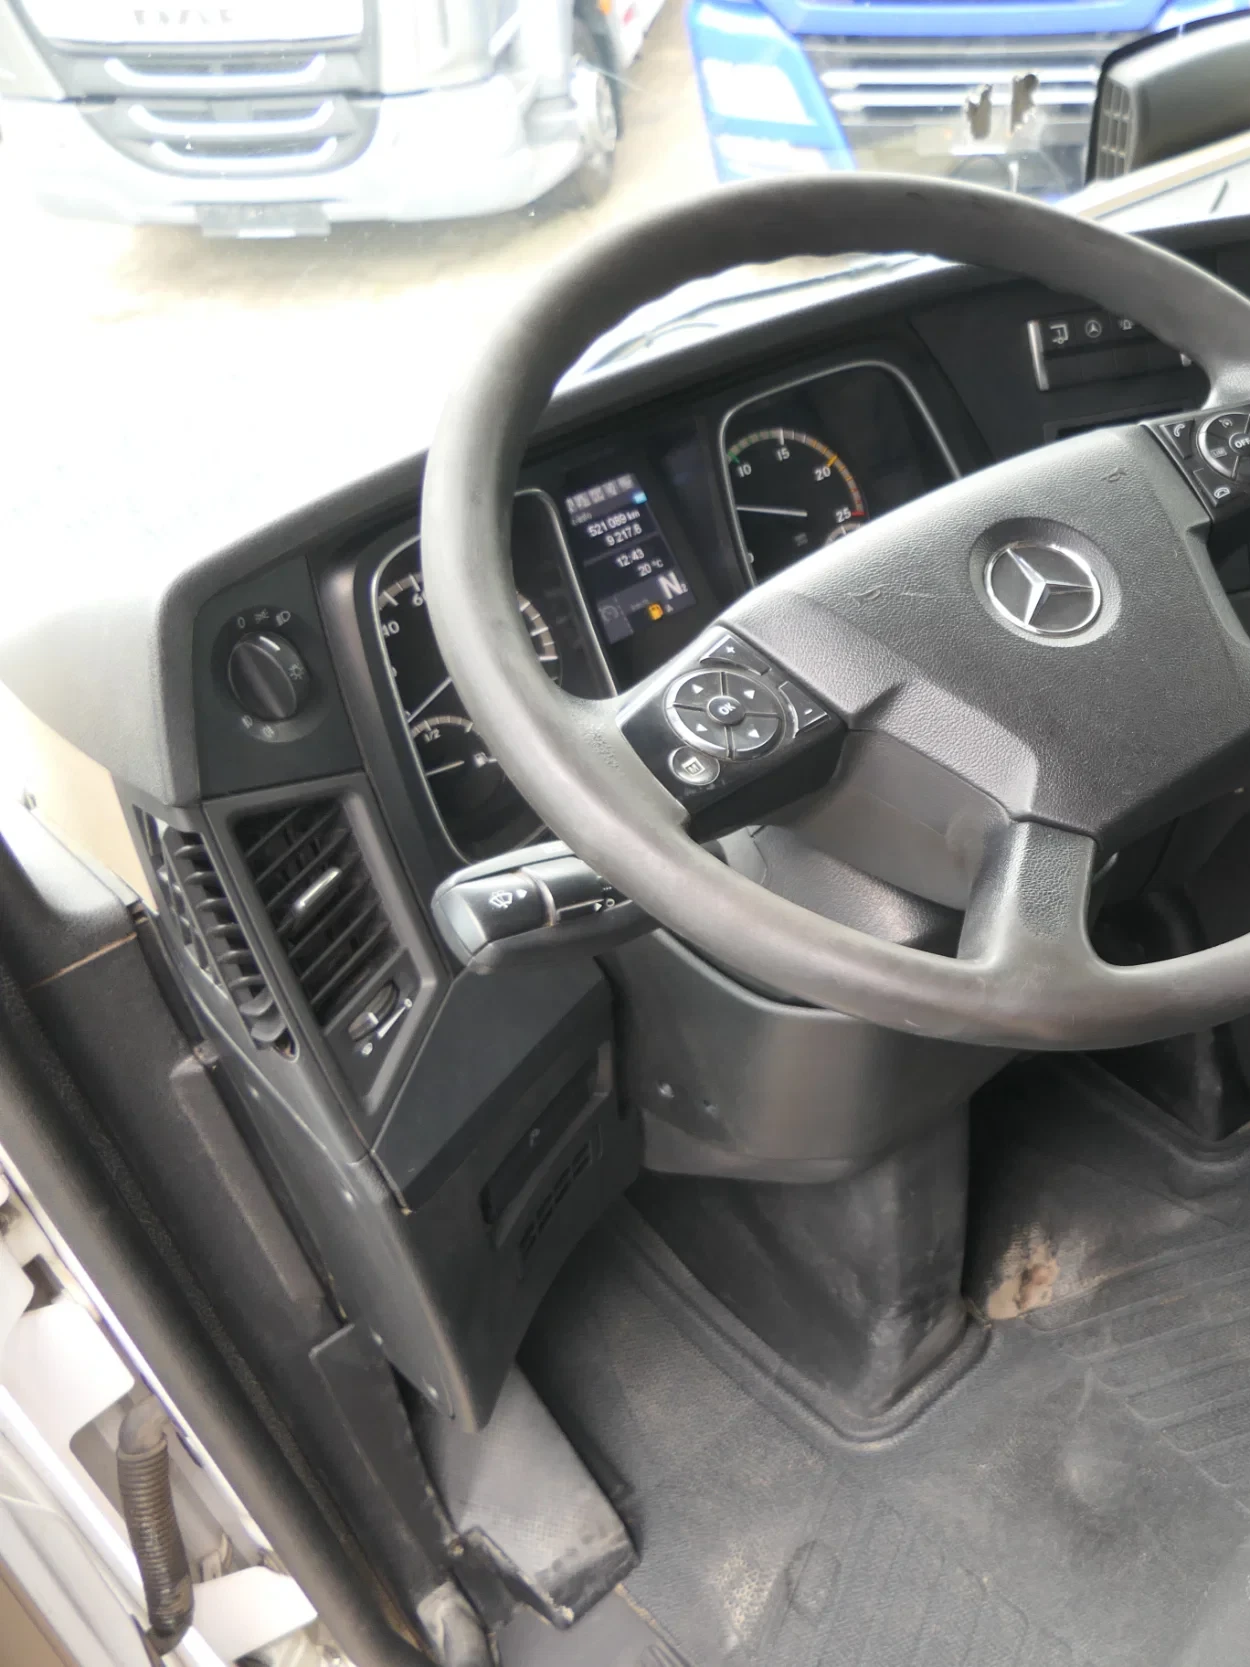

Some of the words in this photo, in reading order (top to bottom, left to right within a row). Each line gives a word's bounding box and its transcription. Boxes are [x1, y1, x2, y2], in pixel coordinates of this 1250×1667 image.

[1234, 436, 1250, 449] OFF
[776, 447, 790, 462] 15
[737, 463, 752, 479] 10
[815, 465, 832, 483] 20
[835, 506, 853, 524] 25
[587, 522, 608, 538] 521
[608, 513, 628, 529] 089
[626, 509, 641, 521] km
[615, 548, 645, 568] 12:43
[637, 562, 652, 577] 20
[718, 702, 735, 715] OK
